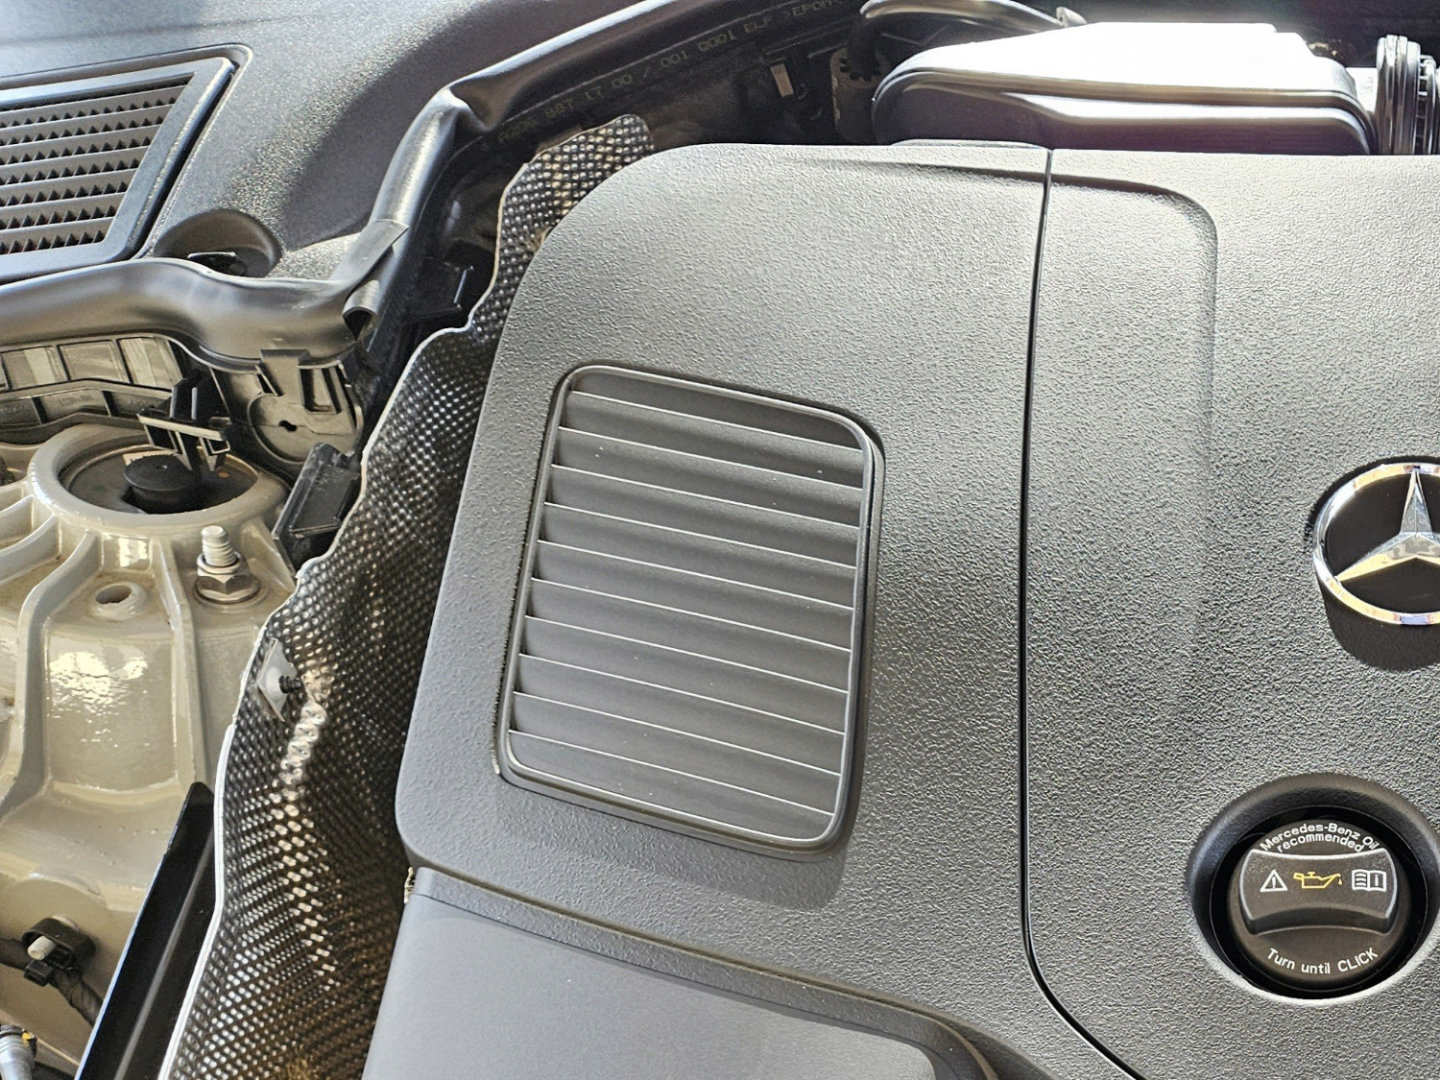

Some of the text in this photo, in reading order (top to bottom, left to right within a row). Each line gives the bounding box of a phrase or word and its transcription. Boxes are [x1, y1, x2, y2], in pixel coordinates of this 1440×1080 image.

[1260, 821, 1380, 852] Mercedes-Benz Oil
[1276, 832, 1365, 853] recommended
[1267, 946, 1379, 975] Turn until CLICK
